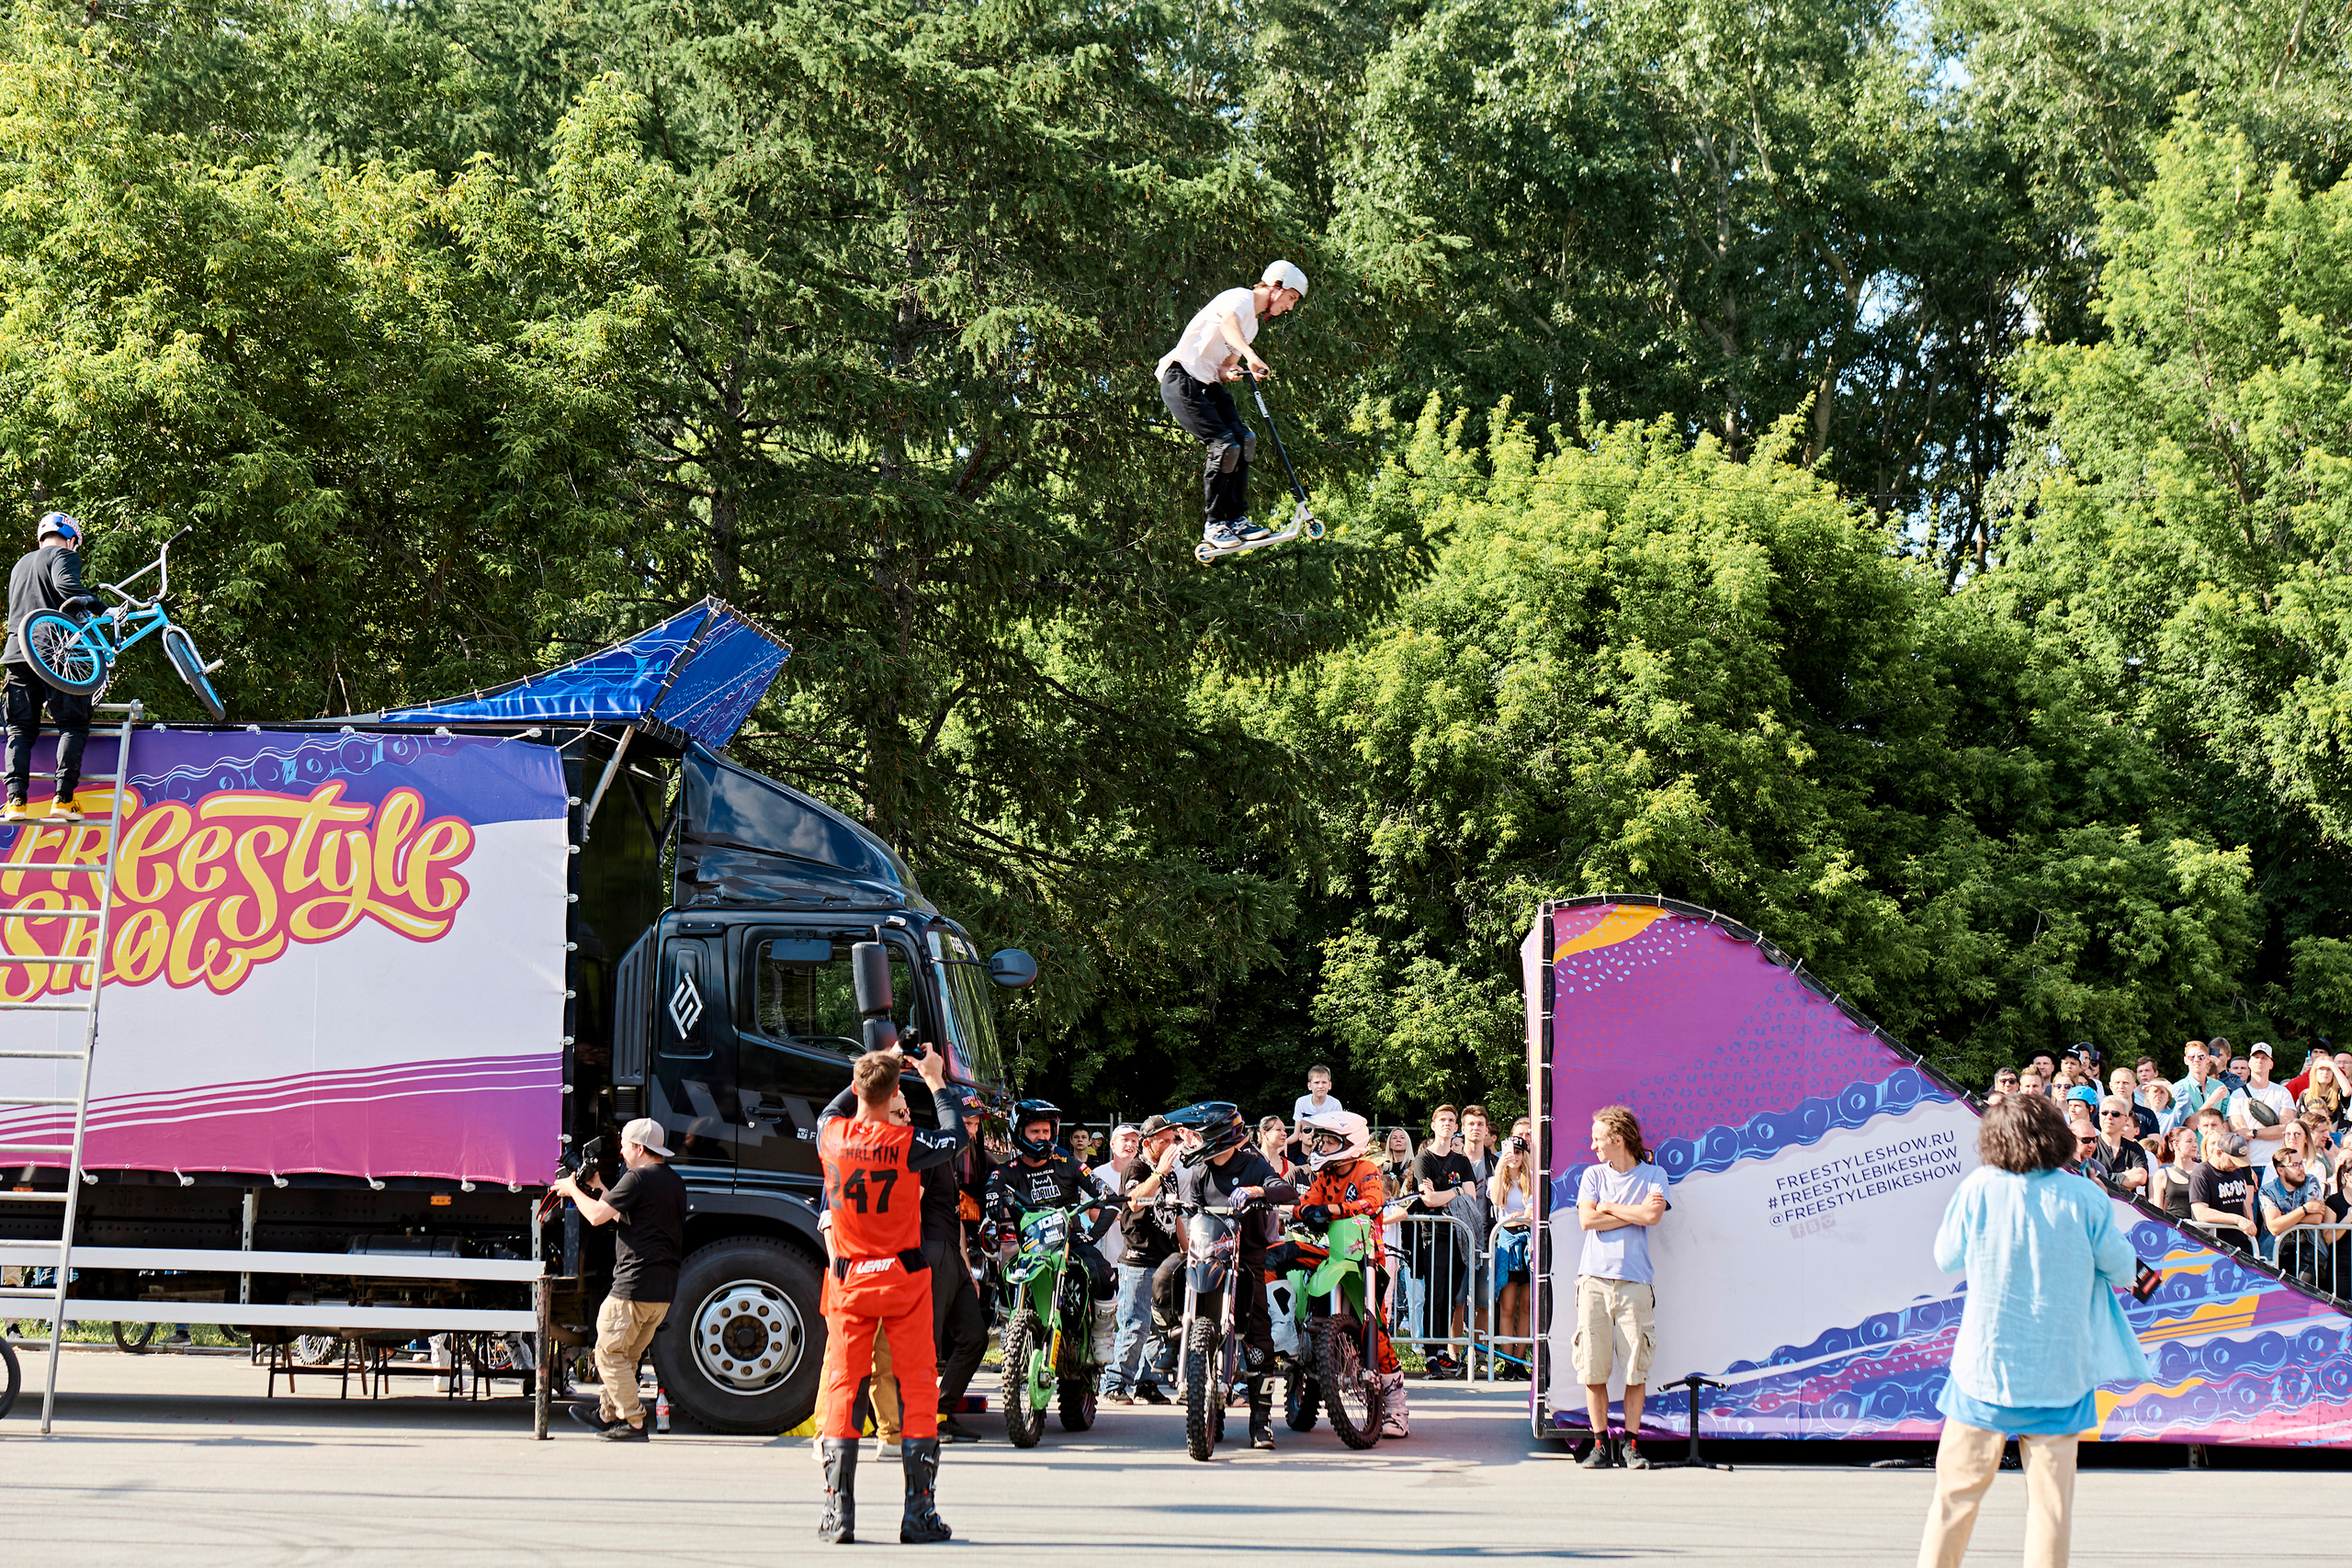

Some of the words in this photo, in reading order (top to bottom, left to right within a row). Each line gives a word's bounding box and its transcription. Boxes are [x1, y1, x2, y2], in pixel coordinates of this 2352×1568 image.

[915, 1132, 956, 1149] LEATT
[1776, 1130, 1955, 1190] FREESTYLESHOW.RU
[1031, 1168, 1055, 1178] TRAILHEAD
[1768, 1145, 1959, 1210] #FREESTYLEBIKESHOW
[827, 1164, 899, 1214] 247
[1031, 1185, 1061, 1201] GORILLA
[1769, 1161, 1962, 1228] @FREESTYLEBIKESHOW
[1037, 1213, 1064, 1231] 102
[855, 1258, 897, 1275] LEATT
